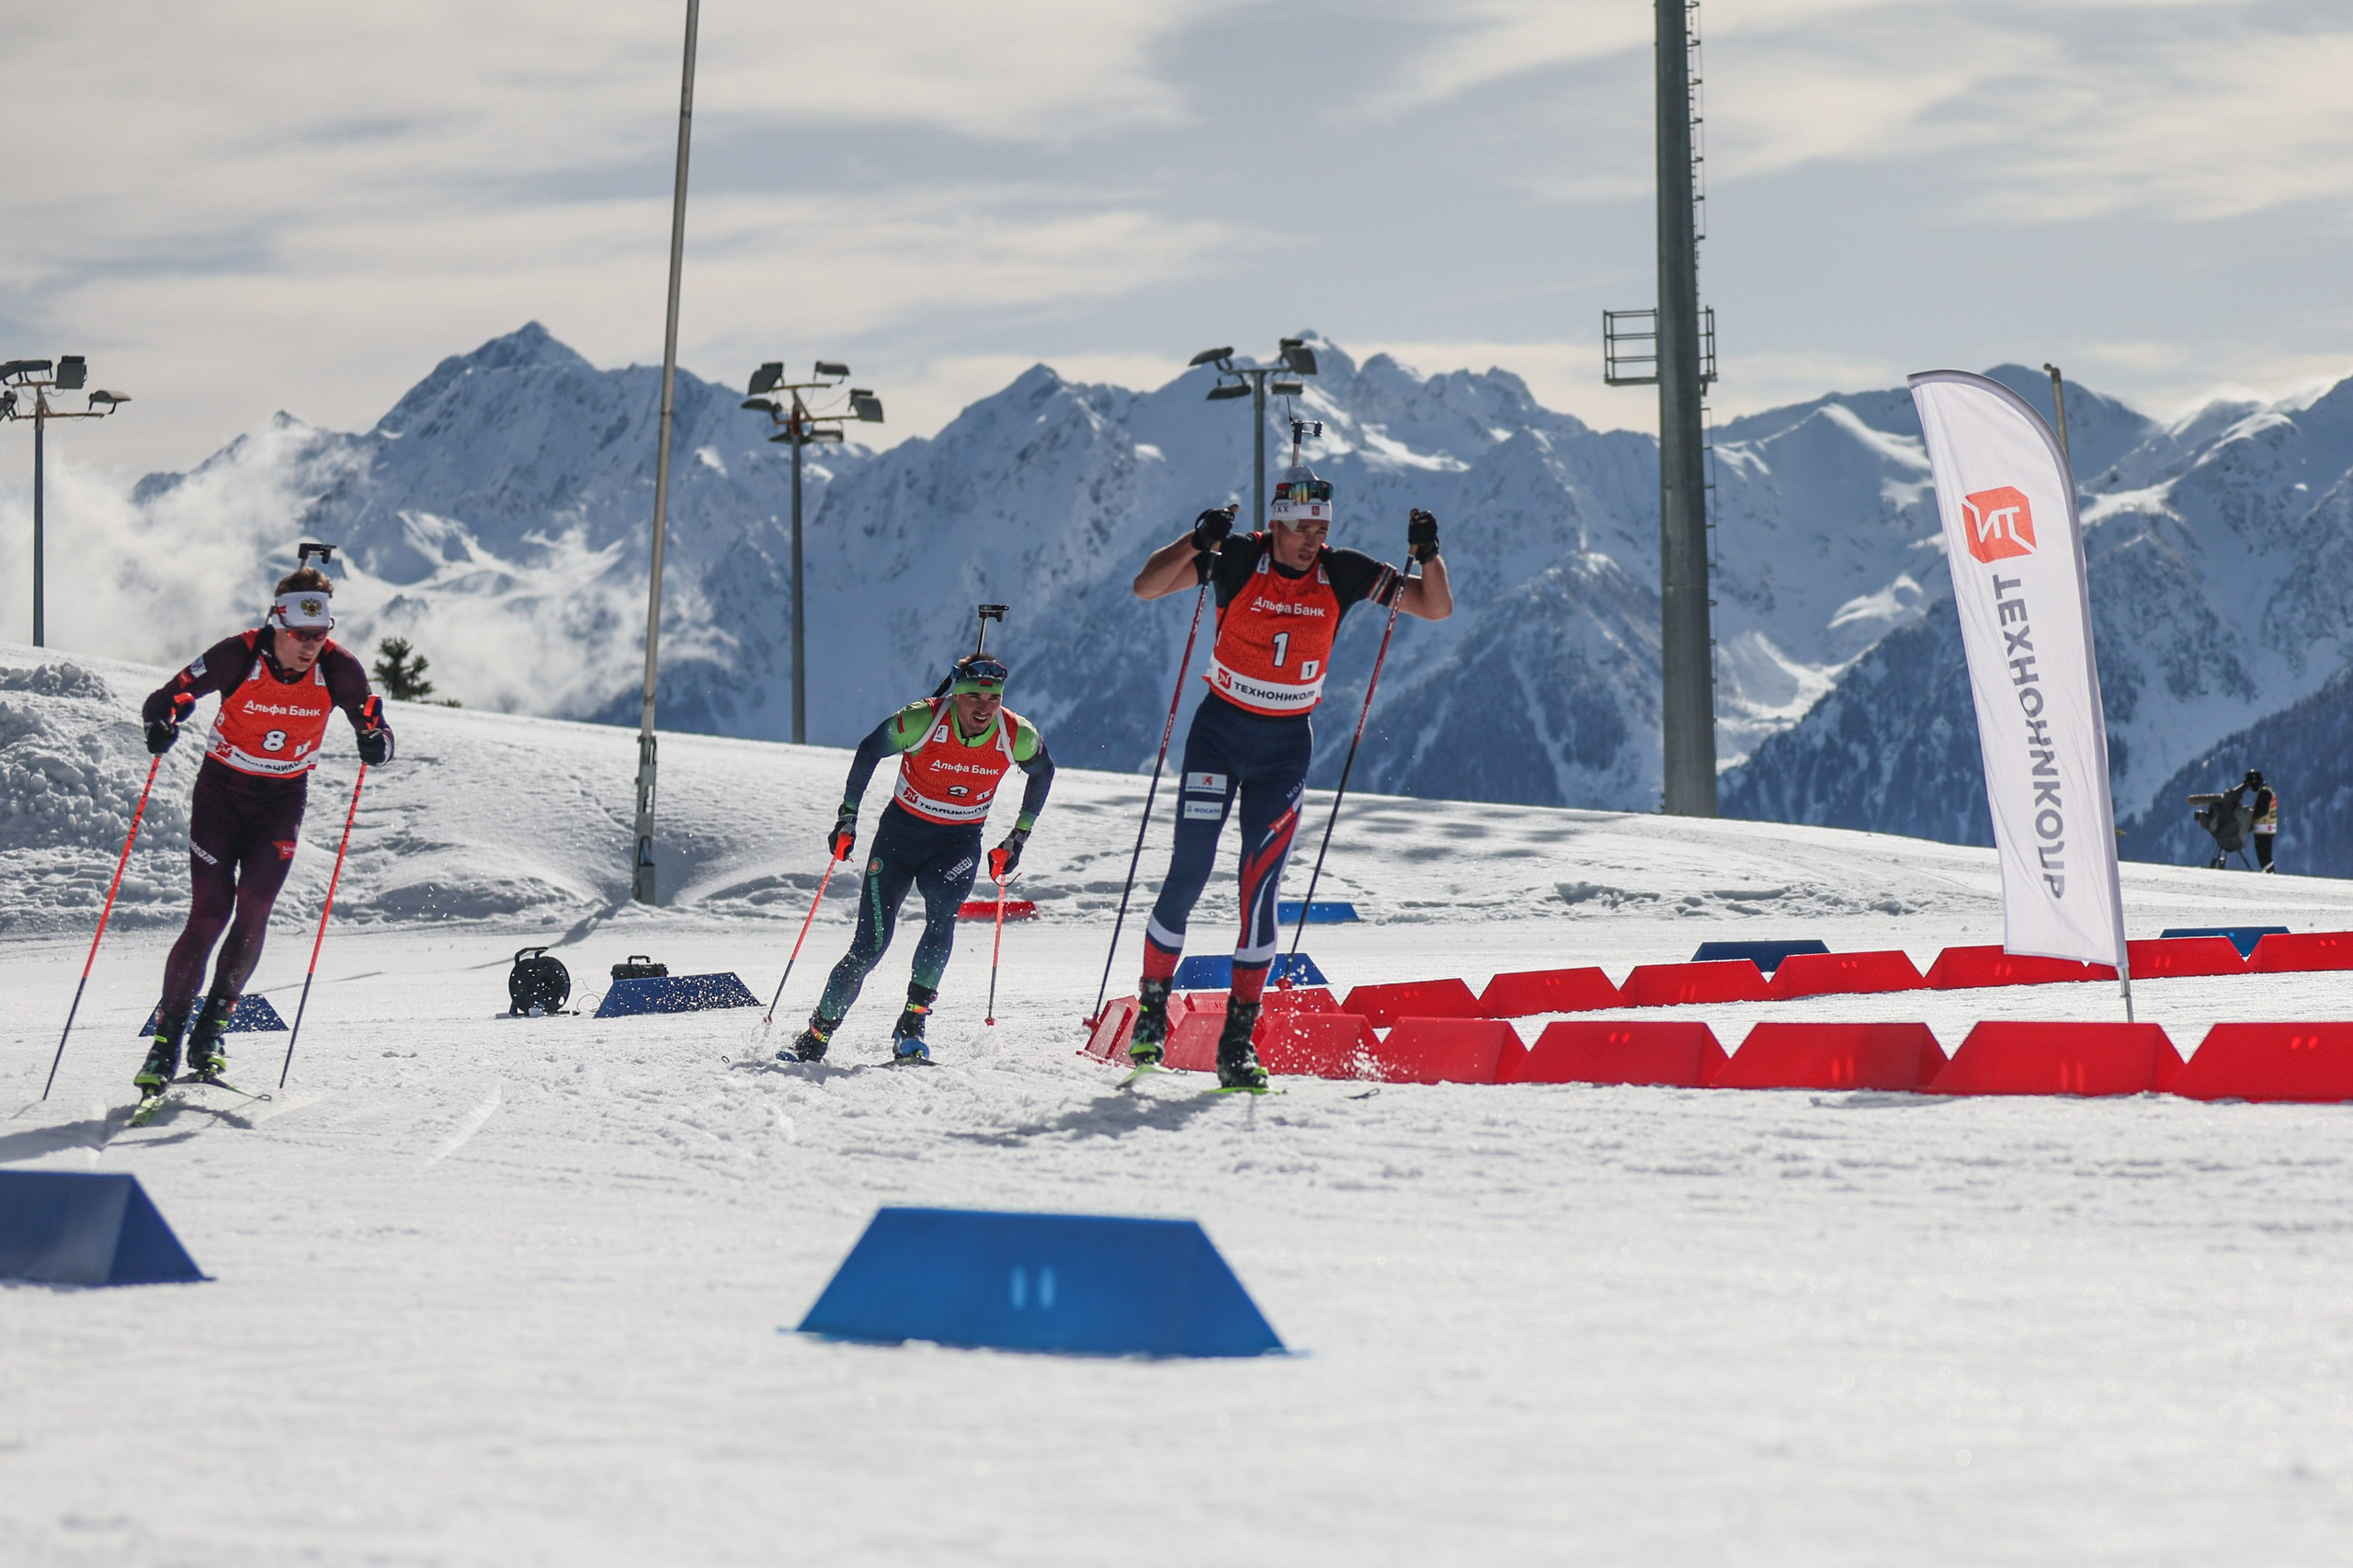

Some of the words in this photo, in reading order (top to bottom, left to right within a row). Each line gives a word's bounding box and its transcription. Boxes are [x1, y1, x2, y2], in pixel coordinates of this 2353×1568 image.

[1251, 597, 1291, 614] Альфа
[1293, 603, 1324, 617] Банк
[1272, 631, 1290, 667] 1
[1307, 664, 1313, 676] 1
[244, 700, 287, 715] Альфа
[289, 706, 321, 716] Банк
[262, 730, 287, 752] 8
[930, 759, 970, 773] Альфа
[972, 765, 999, 775] Банк
[948, 785, 970, 798] 2
